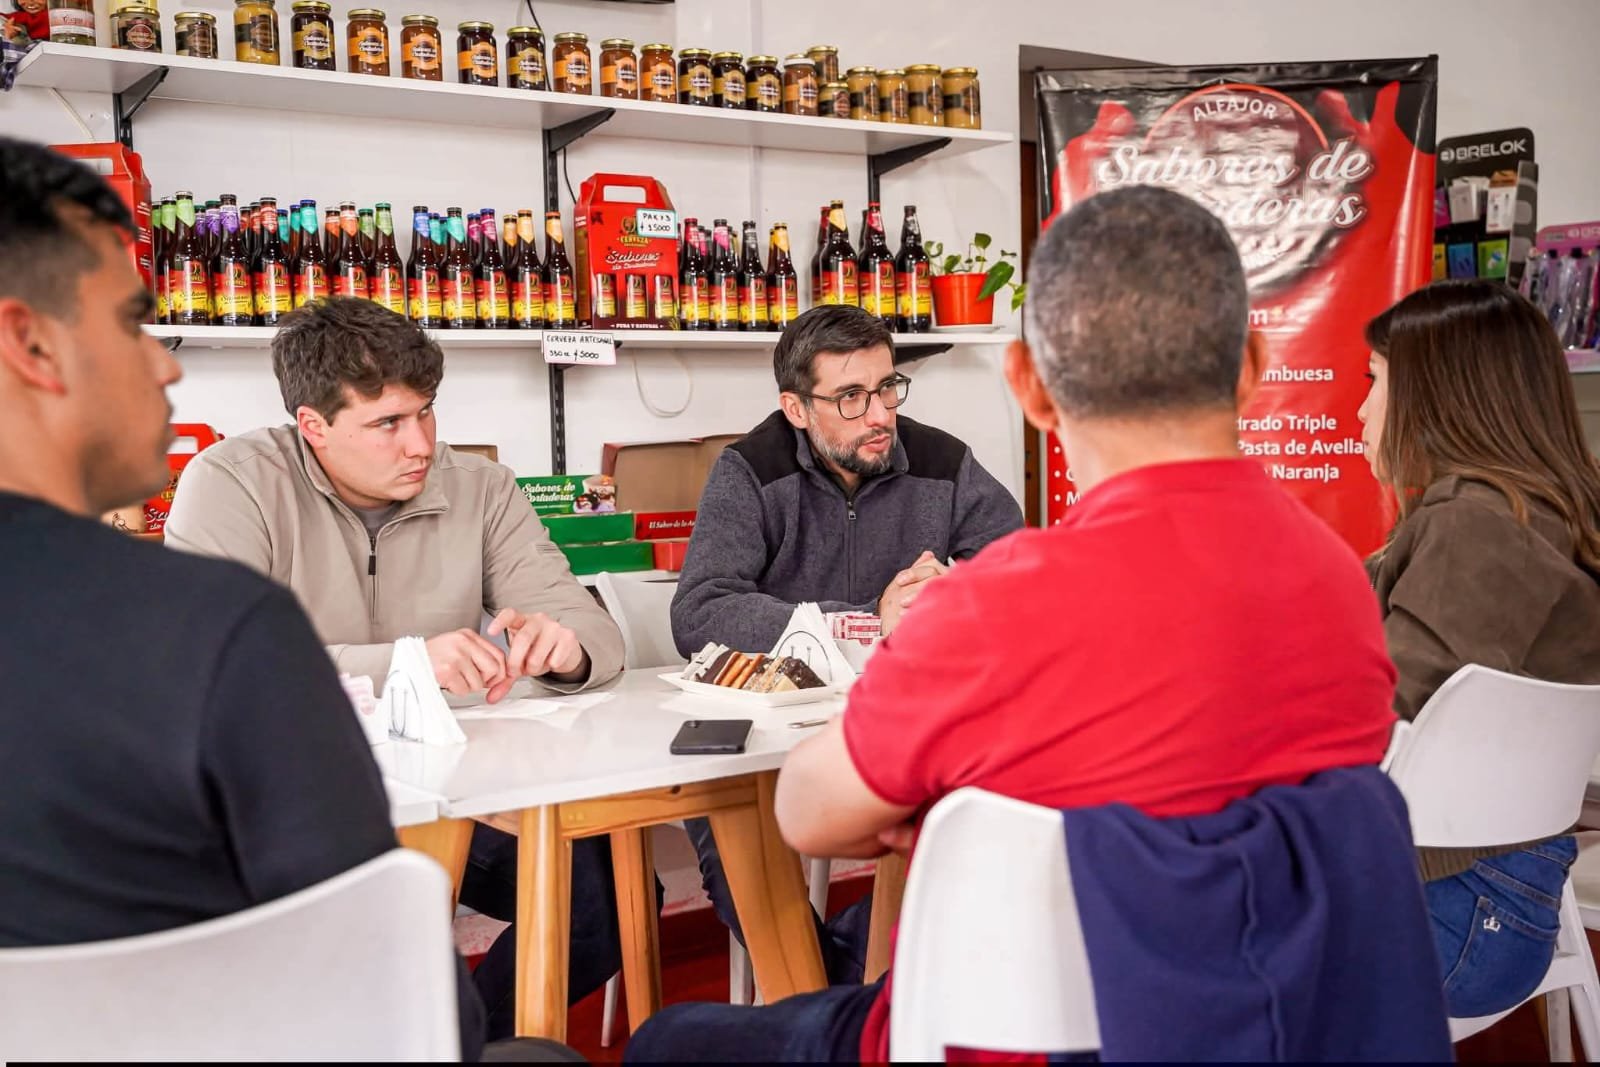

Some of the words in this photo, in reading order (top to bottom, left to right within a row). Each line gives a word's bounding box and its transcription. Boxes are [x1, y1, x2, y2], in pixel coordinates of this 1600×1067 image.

[1193, 96, 1277, 121] ALFAJOR
[1456, 139, 1526, 160] BRELOK
[1097, 144, 1299, 187] Sabores
[1309, 137, 1372, 181] de
[546, 335, 577, 343] CERVEZA
[1286, 415, 1337, 434] Triple
[1285, 440, 1307, 455] de
[1311, 438, 1365, 455] Avella
[1272, 464, 1340, 483] Naranja
[522, 482, 561, 493] Sabores
[564, 482, 575, 491] de
